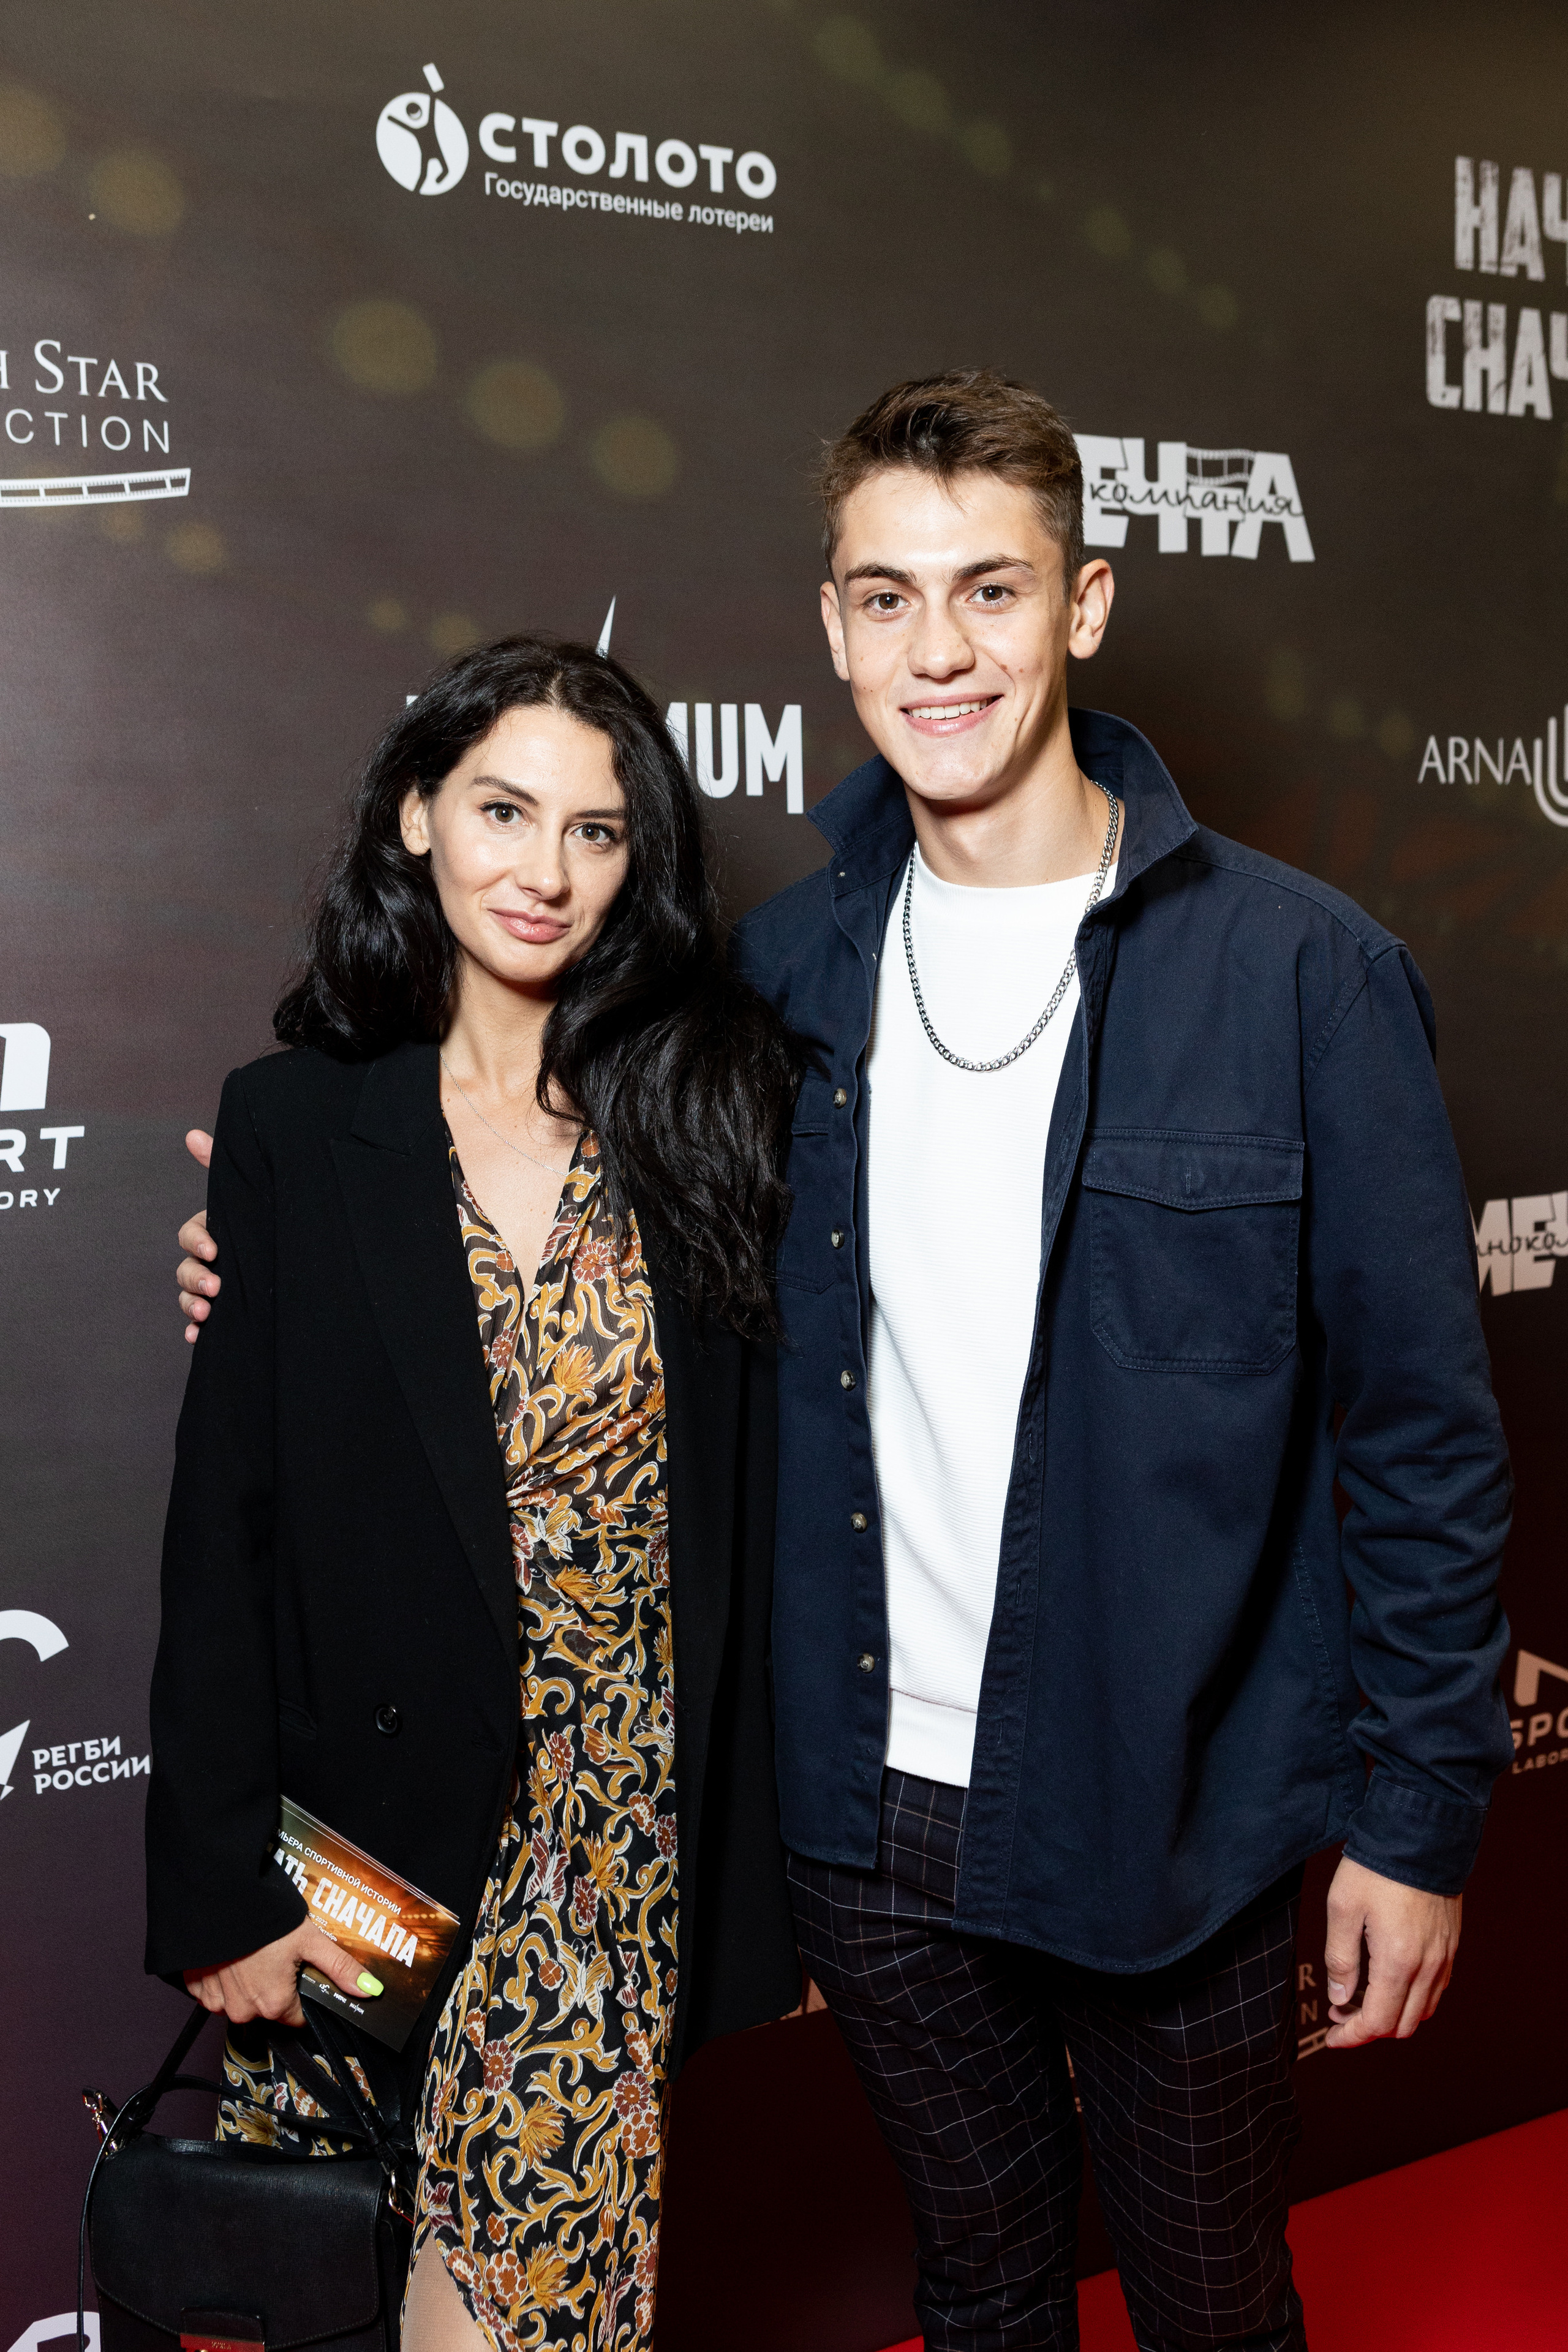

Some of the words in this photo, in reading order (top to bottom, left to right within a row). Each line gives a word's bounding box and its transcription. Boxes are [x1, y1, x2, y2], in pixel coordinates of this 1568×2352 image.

[478, 112, 777, 199] СТОЛОТО
[484, 172, 684, 221] Государственные
[687, 205, 774, 234] лотереи
[5, 408, 170, 453] CTION
[1073, 432, 1316, 562] ЕЧТА
[32, 1735, 121, 1770] РЕГБИ
[33, 1754, 151, 1795] РОССИИ
[277, 1828, 304, 1852] МЬЕРА
[304, 1847, 361, 1889] СПОРТИВНОЙ
[360, 1883, 402, 1916] ИСТОРИИ
[311, 1877, 418, 1968] СНАЧАЛА
